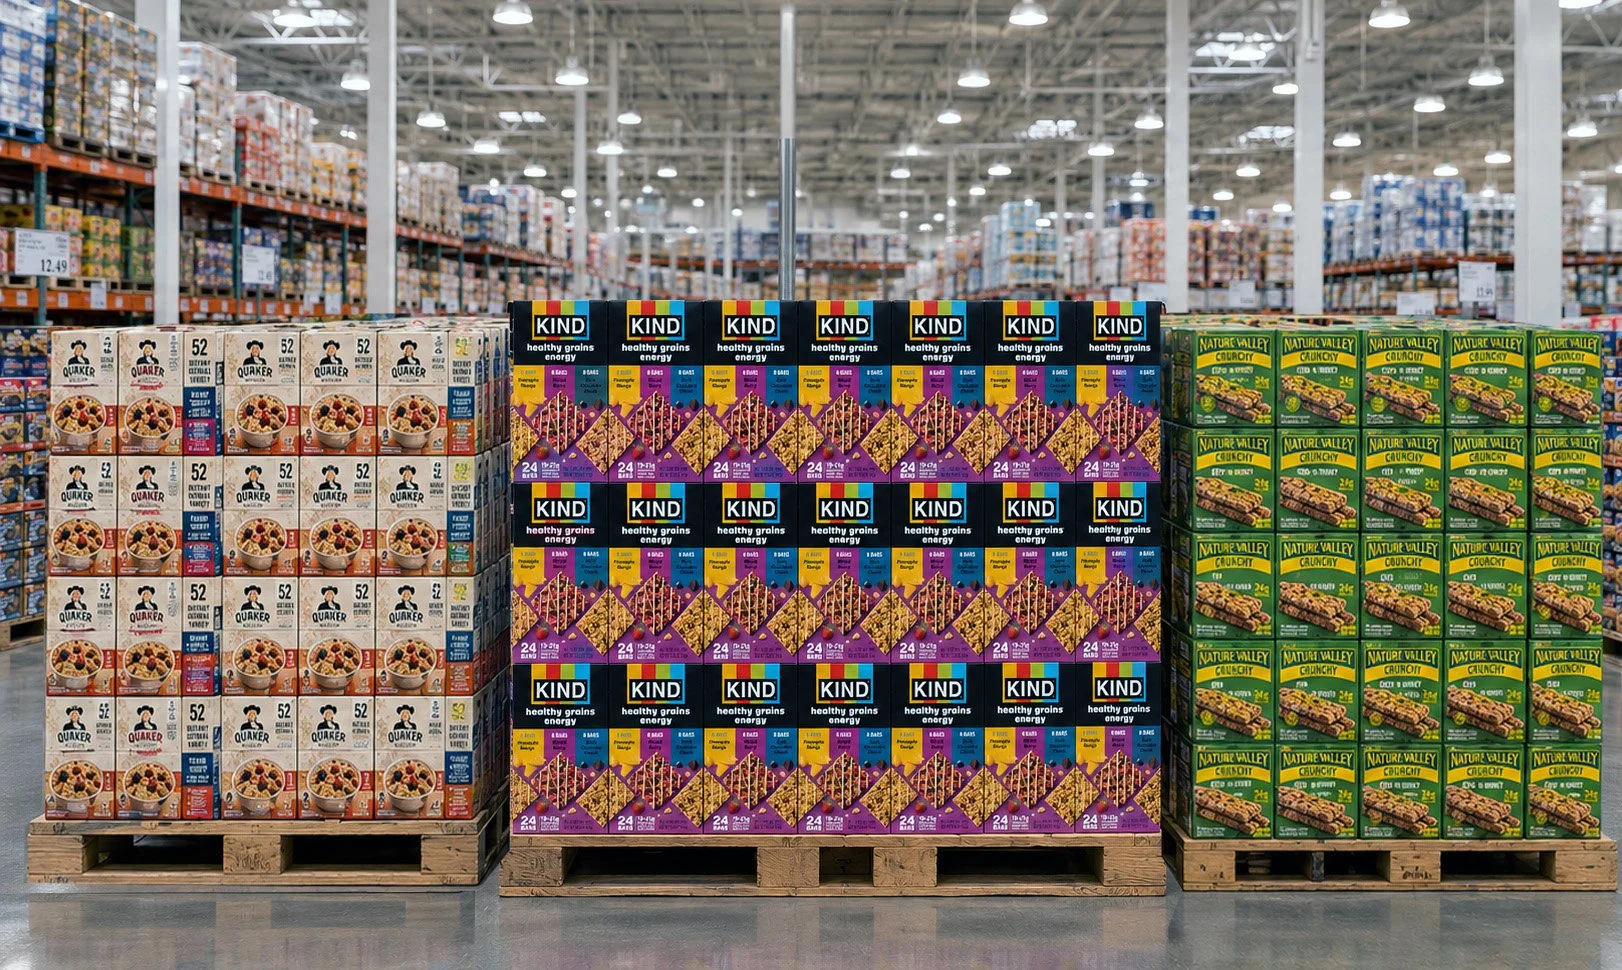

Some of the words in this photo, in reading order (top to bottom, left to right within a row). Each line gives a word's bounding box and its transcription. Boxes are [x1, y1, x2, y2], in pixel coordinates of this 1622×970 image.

[41, 259, 67, 273] 12.49
[537, 318, 584, 333] KIND
[632, 318, 679, 334] KIND
[728, 318, 775, 334] KIND
[822, 318, 868, 334] KIND
[915, 318, 961, 334] KIND
[1008, 318, 1054, 334] KIND
[1098, 318, 1142, 334] KIND
[192, 338, 207, 356] 52
[357, 339, 370, 354] 52
[527, 343, 561, 353] healthy
[565, 343, 594, 353] grains
[622, 343, 657, 353] healthy
[660, 343, 690, 353] grains
[717, 343, 752, 353] healthy
[755, 343, 784, 353] grains
[812, 343, 846, 353] healthy
[849, 343, 877, 353] grains
[905, 343, 939, 353] healthy
[942, 343, 971, 353] grains
[998, 343, 1032, 353] healthy
[1035, 343, 1063, 353] grains
[1089, 343, 1121, 353] healthy
[1124, 343, 1150, 353] grains
[279, 463, 292, 479] 52
[356, 463, 369, 479] 52
[522, 462, 537, 472] 24
[618, 462, 633, 472] 24
[714, 462, 729, 472] 24
[807, 462, 822, 472] 24
[901, 462, 915, 472] 24
[994, 462, 1008, 472] 24
[1084, 461, 1099, 471] 24
[192, 463, 206, 480] 52
[537, 501, 585, 517] KIND
[632, 501, 680, 517] KIND
[728, 501, 775, 517] KIND
[822, 501, 868, 517] KIND
[915, 501, 962, 517] KIND
[1008, 501, 1054, 516] KIND
[1098, 500, 1142, 516] KIND
[527, 525, 562, 535] healthy
[565, 525, 594, 535] grains
[622, 526, 657, 536] healthy
[661, 526, 690, 536] grains
[718, 526, 753, 536] healthy
[756, 526, 785, 536] grains
[812, 526, 846, 536] healthy
[849, 526, 878, 536] grains
[905, 526, 939, 536] healthy
[943, 526, 971, 536] grains
[998, 525, 1032, 535] healthy
[1035, 525, 1063, 535] grains
[1089, 525, 1121, 535] healthy
[1124, 525, 1150, 535] grains
[191, 584, 206, 601] 52
[279, 584, 291, 599] 52
[355, 584, 368, 599] 52
[521, 643, 536, 653] 24
[618, 643, 633, 653] 24
[807, 643, 822, 653] 24
[993, 642, 1008, 652] 24
[537, 682, 585, 698] KIND
[632, 682, 680, 698] KIND
[728, 682, 775, 697] KIND
[822, 682, 868, 697] KIND
[915, 681, 961, 697] KIND
[1008, 681, 1054, 696] KIND
[1098, 680, 1141, 696] KIND
[190, 704, 205, 721] 52
[278, 703, 290, 719] 52
[355, 703, 367, 719] 52
[526, 707, 561, 717] healthy
[565, 707, 595, 717] grains
[622, 706, 657, 716] healthy
[661, 706, 690, 716] grains
[717, 706, 752, 716] healthy
[756, 706, 784, 716] grains
[811, 706, 846, 716] healthy
[849, 706, 878, 716] grains
[905, 706, 939, 716] healthy
[942, 706, 971, 716] grains
[998, 705, 1032, 715] healthy
[1035, 705, 1063, 715] grains
[1088, 704, 1120, 714] healthy
[1123, 704, 1150, 714] grains
[521, 816, 536, 826] 24
[618, 816, 633, 826] 24
[807, 816, 822, 826] 24
[993, 815, 1008, 825] 24
